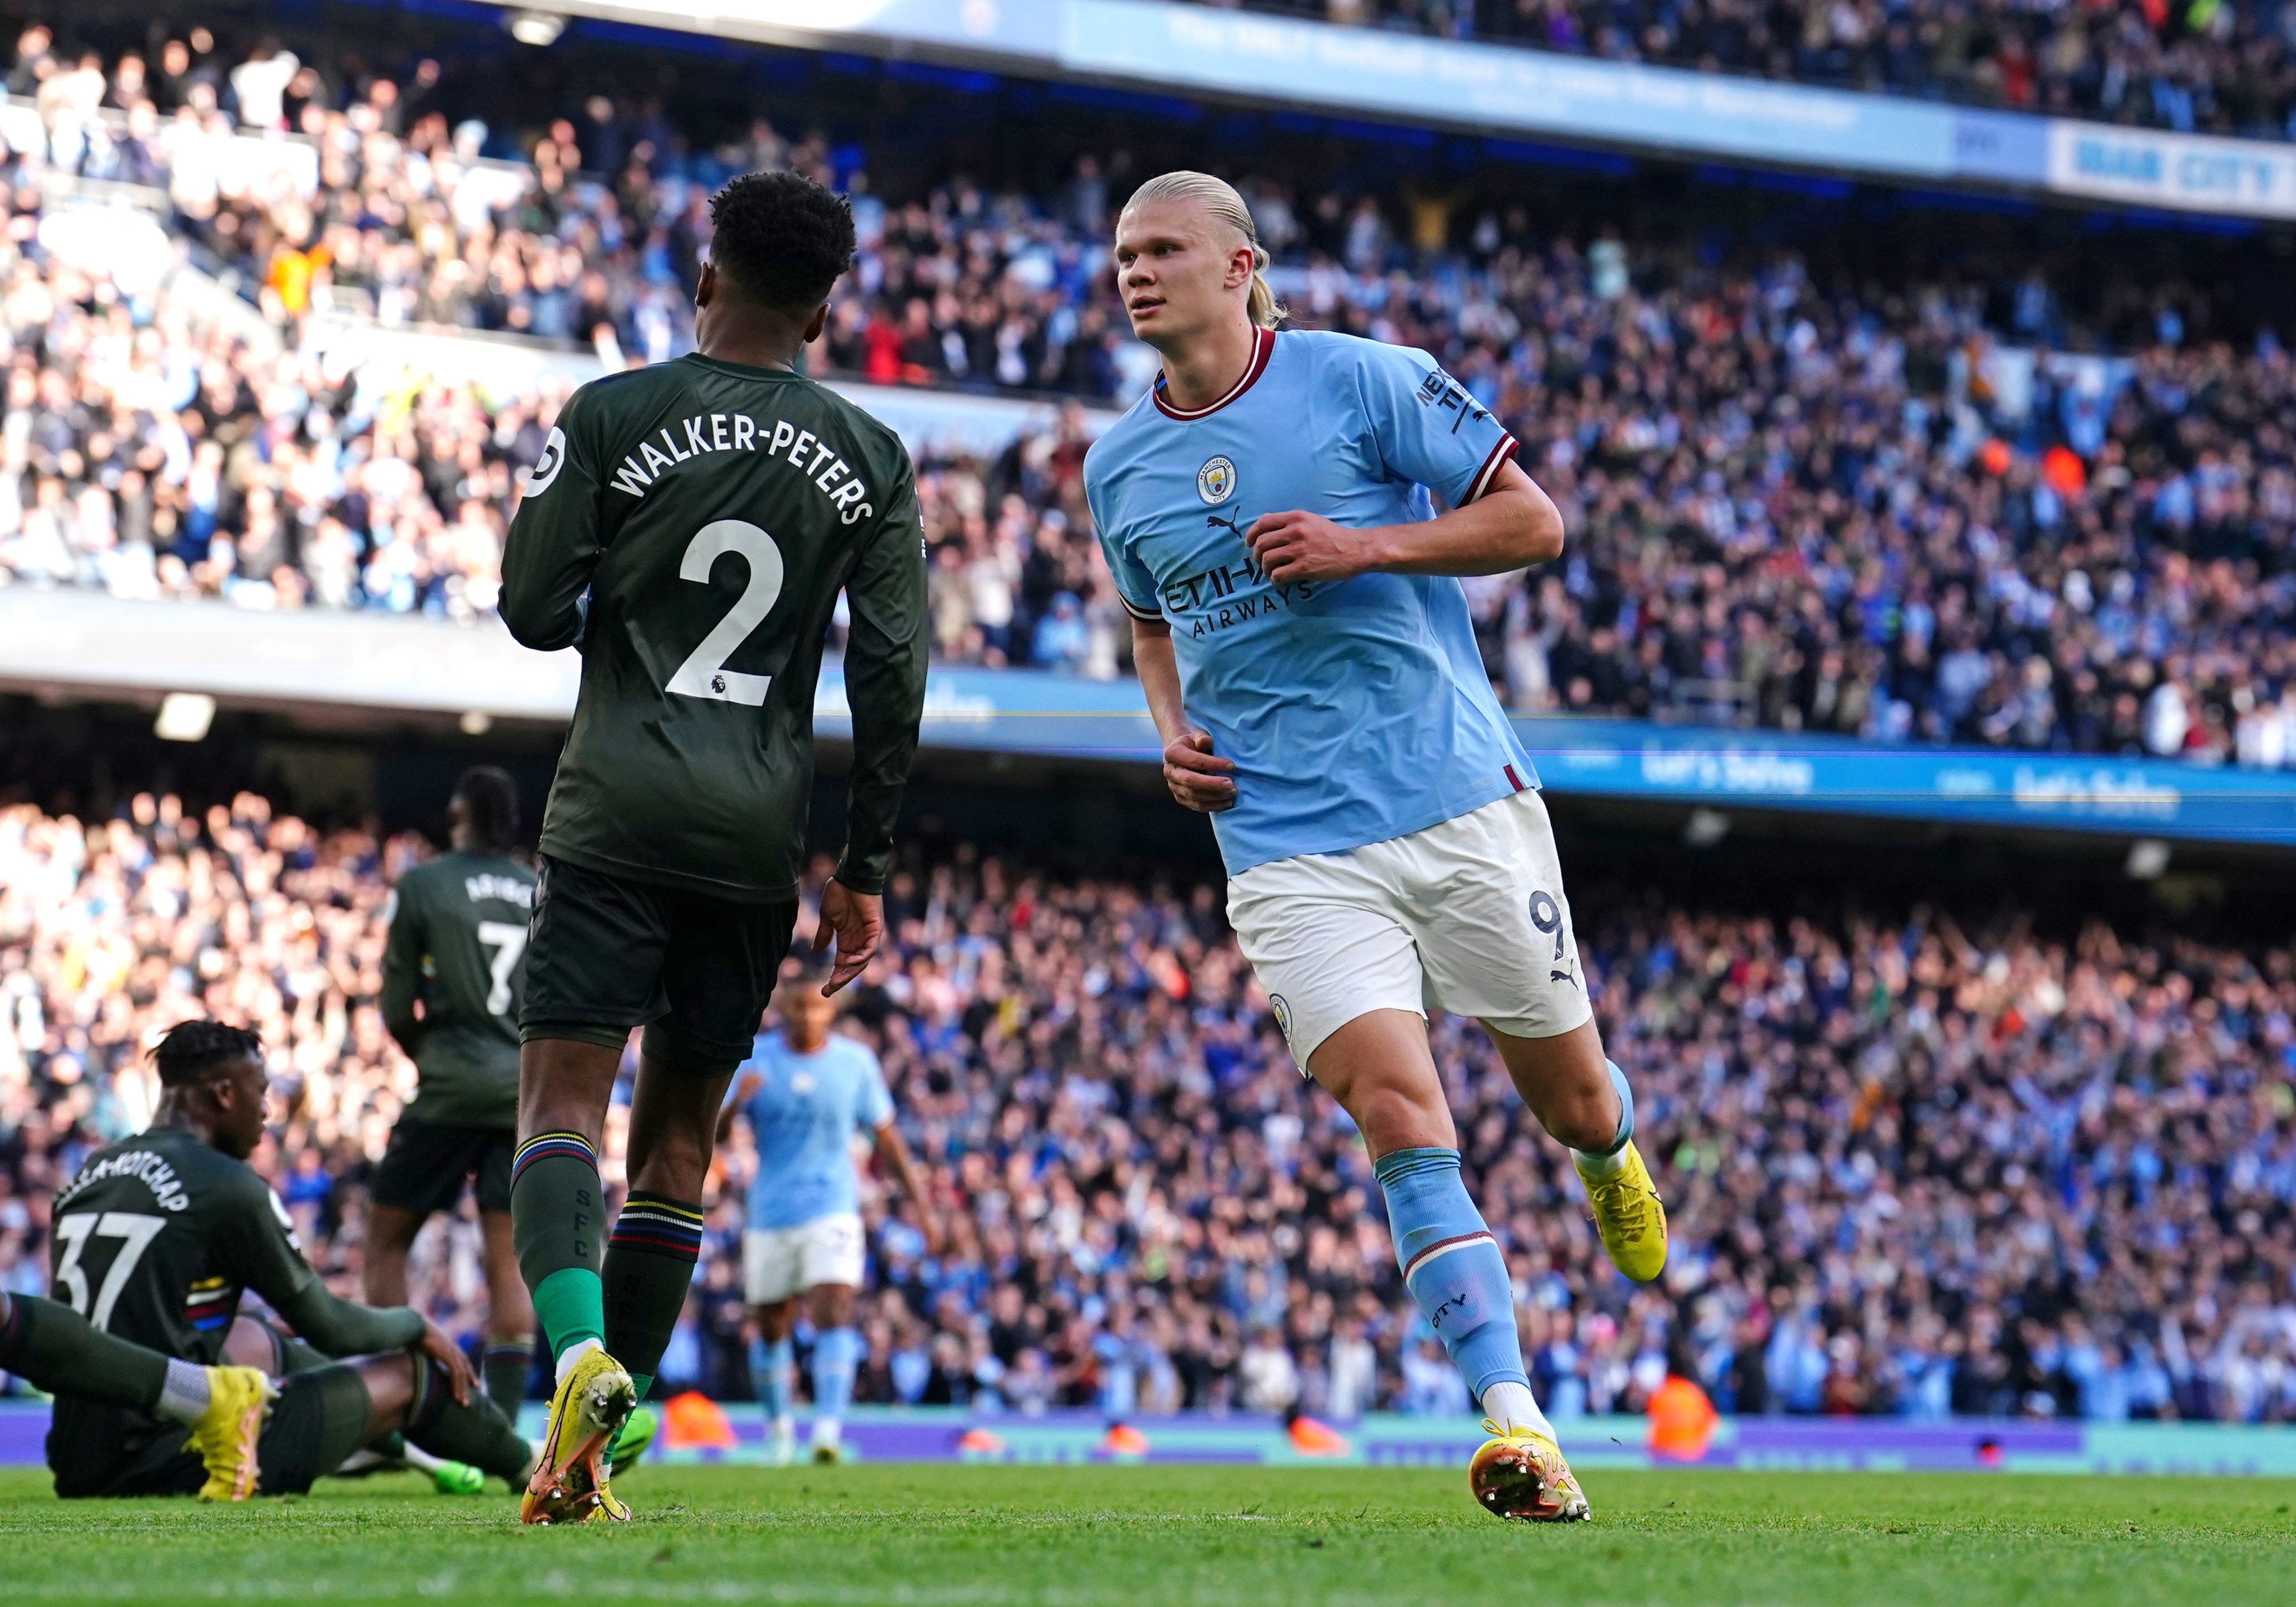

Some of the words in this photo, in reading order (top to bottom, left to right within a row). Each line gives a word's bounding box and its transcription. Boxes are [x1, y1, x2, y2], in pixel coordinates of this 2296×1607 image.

[610, 414, 873, 525] WALKER-PETERS
[1200, 459, 1231, 481] MANCHESTER
[1213, 494, 1226, 502] CITY
[665, 519, 784, 706] 2
[1193, 580, 1312, 638] AIRWAYS
[1529, 890, 1564, 962] 9
[478, 921, 529, 1015] 7
[574, 1189, 591, 1258] SFC
[57, 1212, 167, 1333] 37
